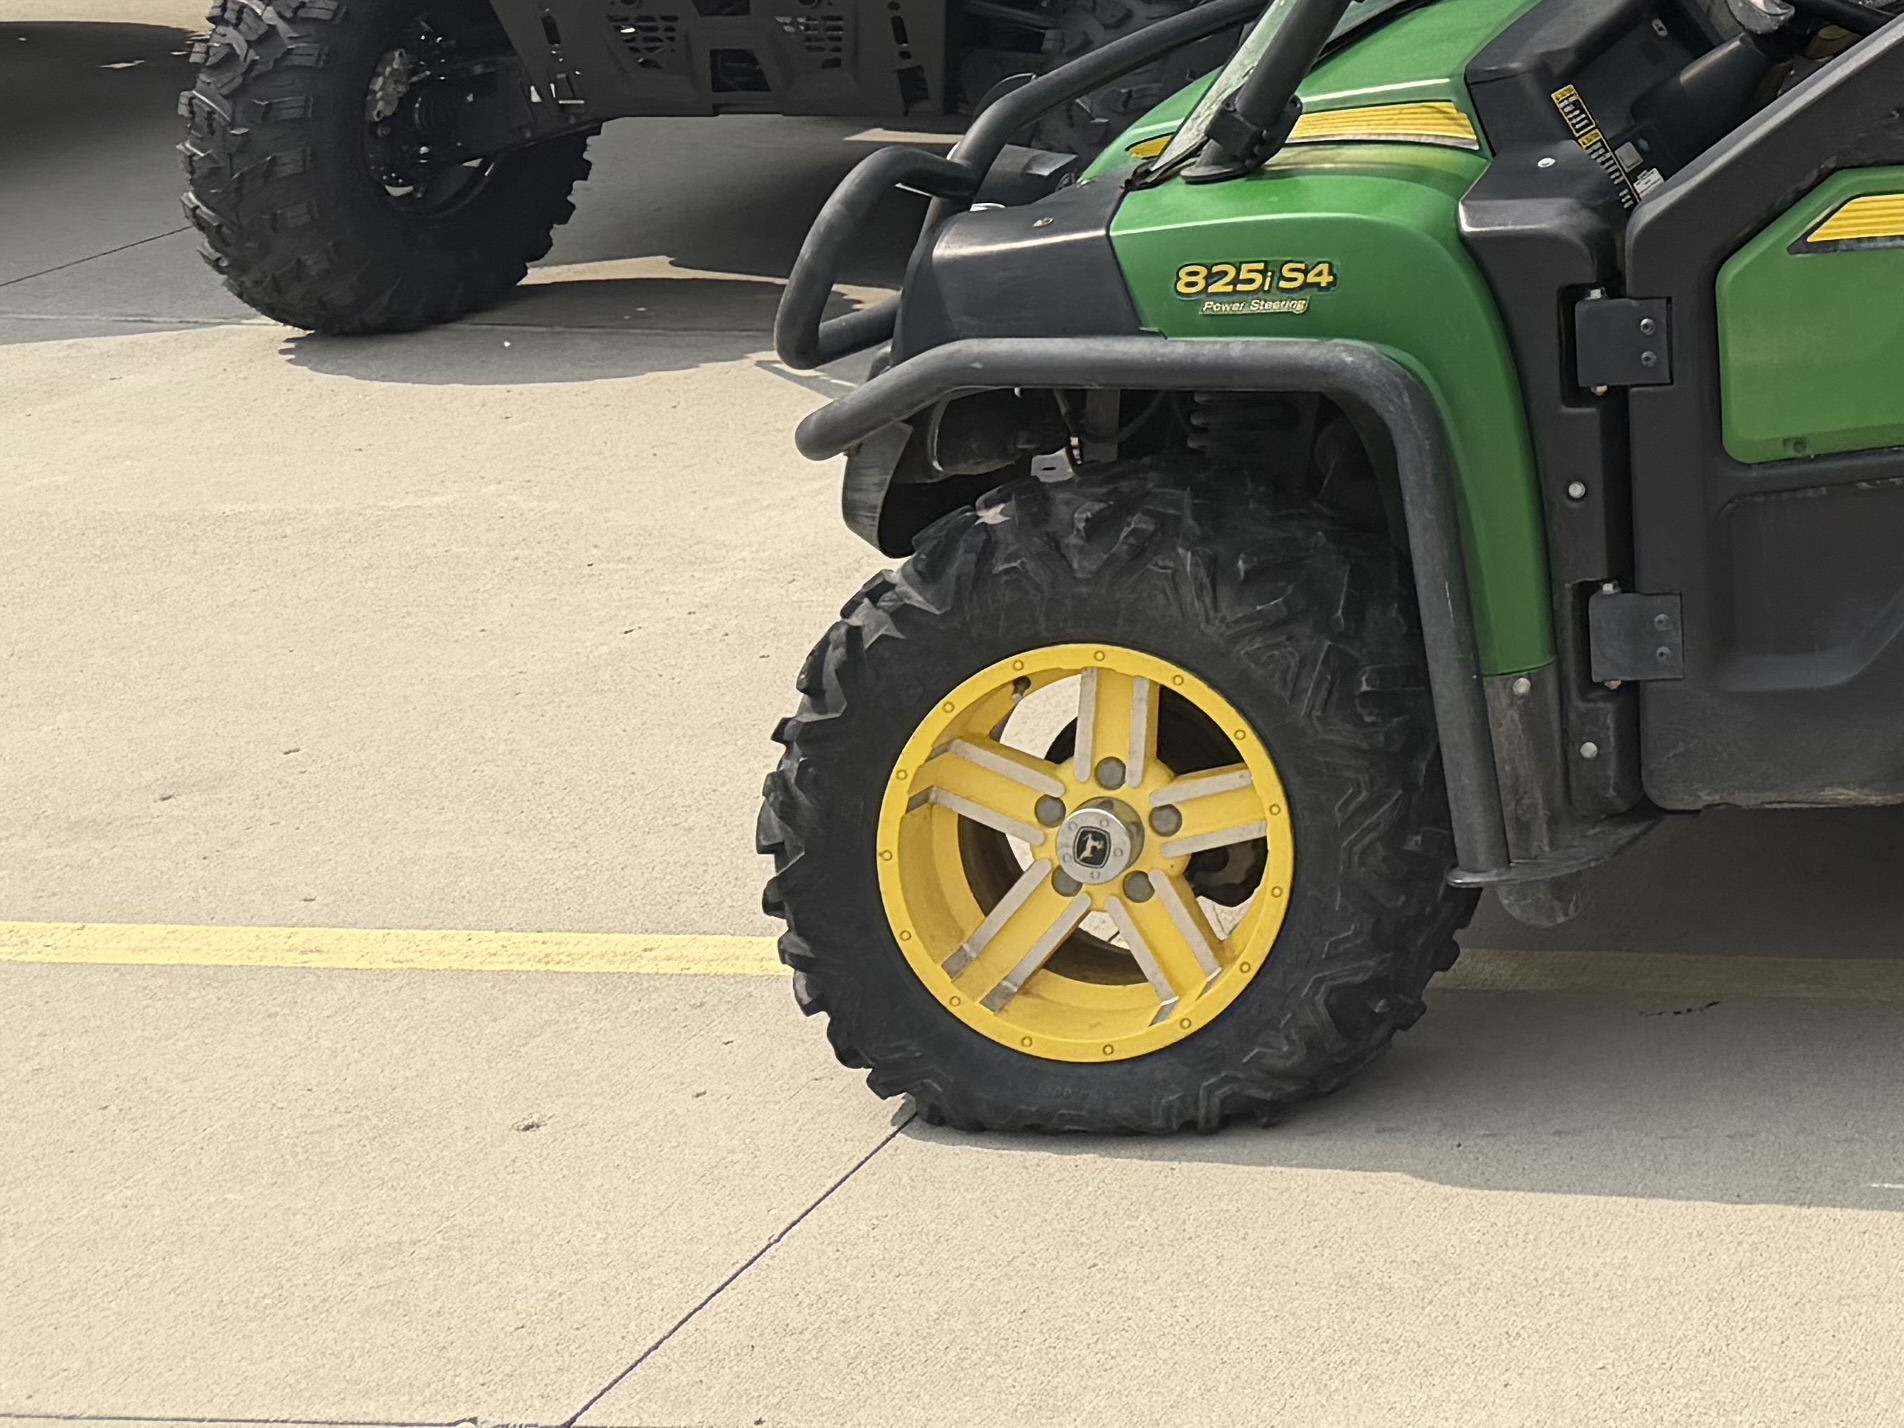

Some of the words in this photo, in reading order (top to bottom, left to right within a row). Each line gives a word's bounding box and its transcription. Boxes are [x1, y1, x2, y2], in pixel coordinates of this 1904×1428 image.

[1278, 262, 1334, 289] S4
[1202, 301, 1245, 312] Power
[1250, 299, 1307, 313] Steering
